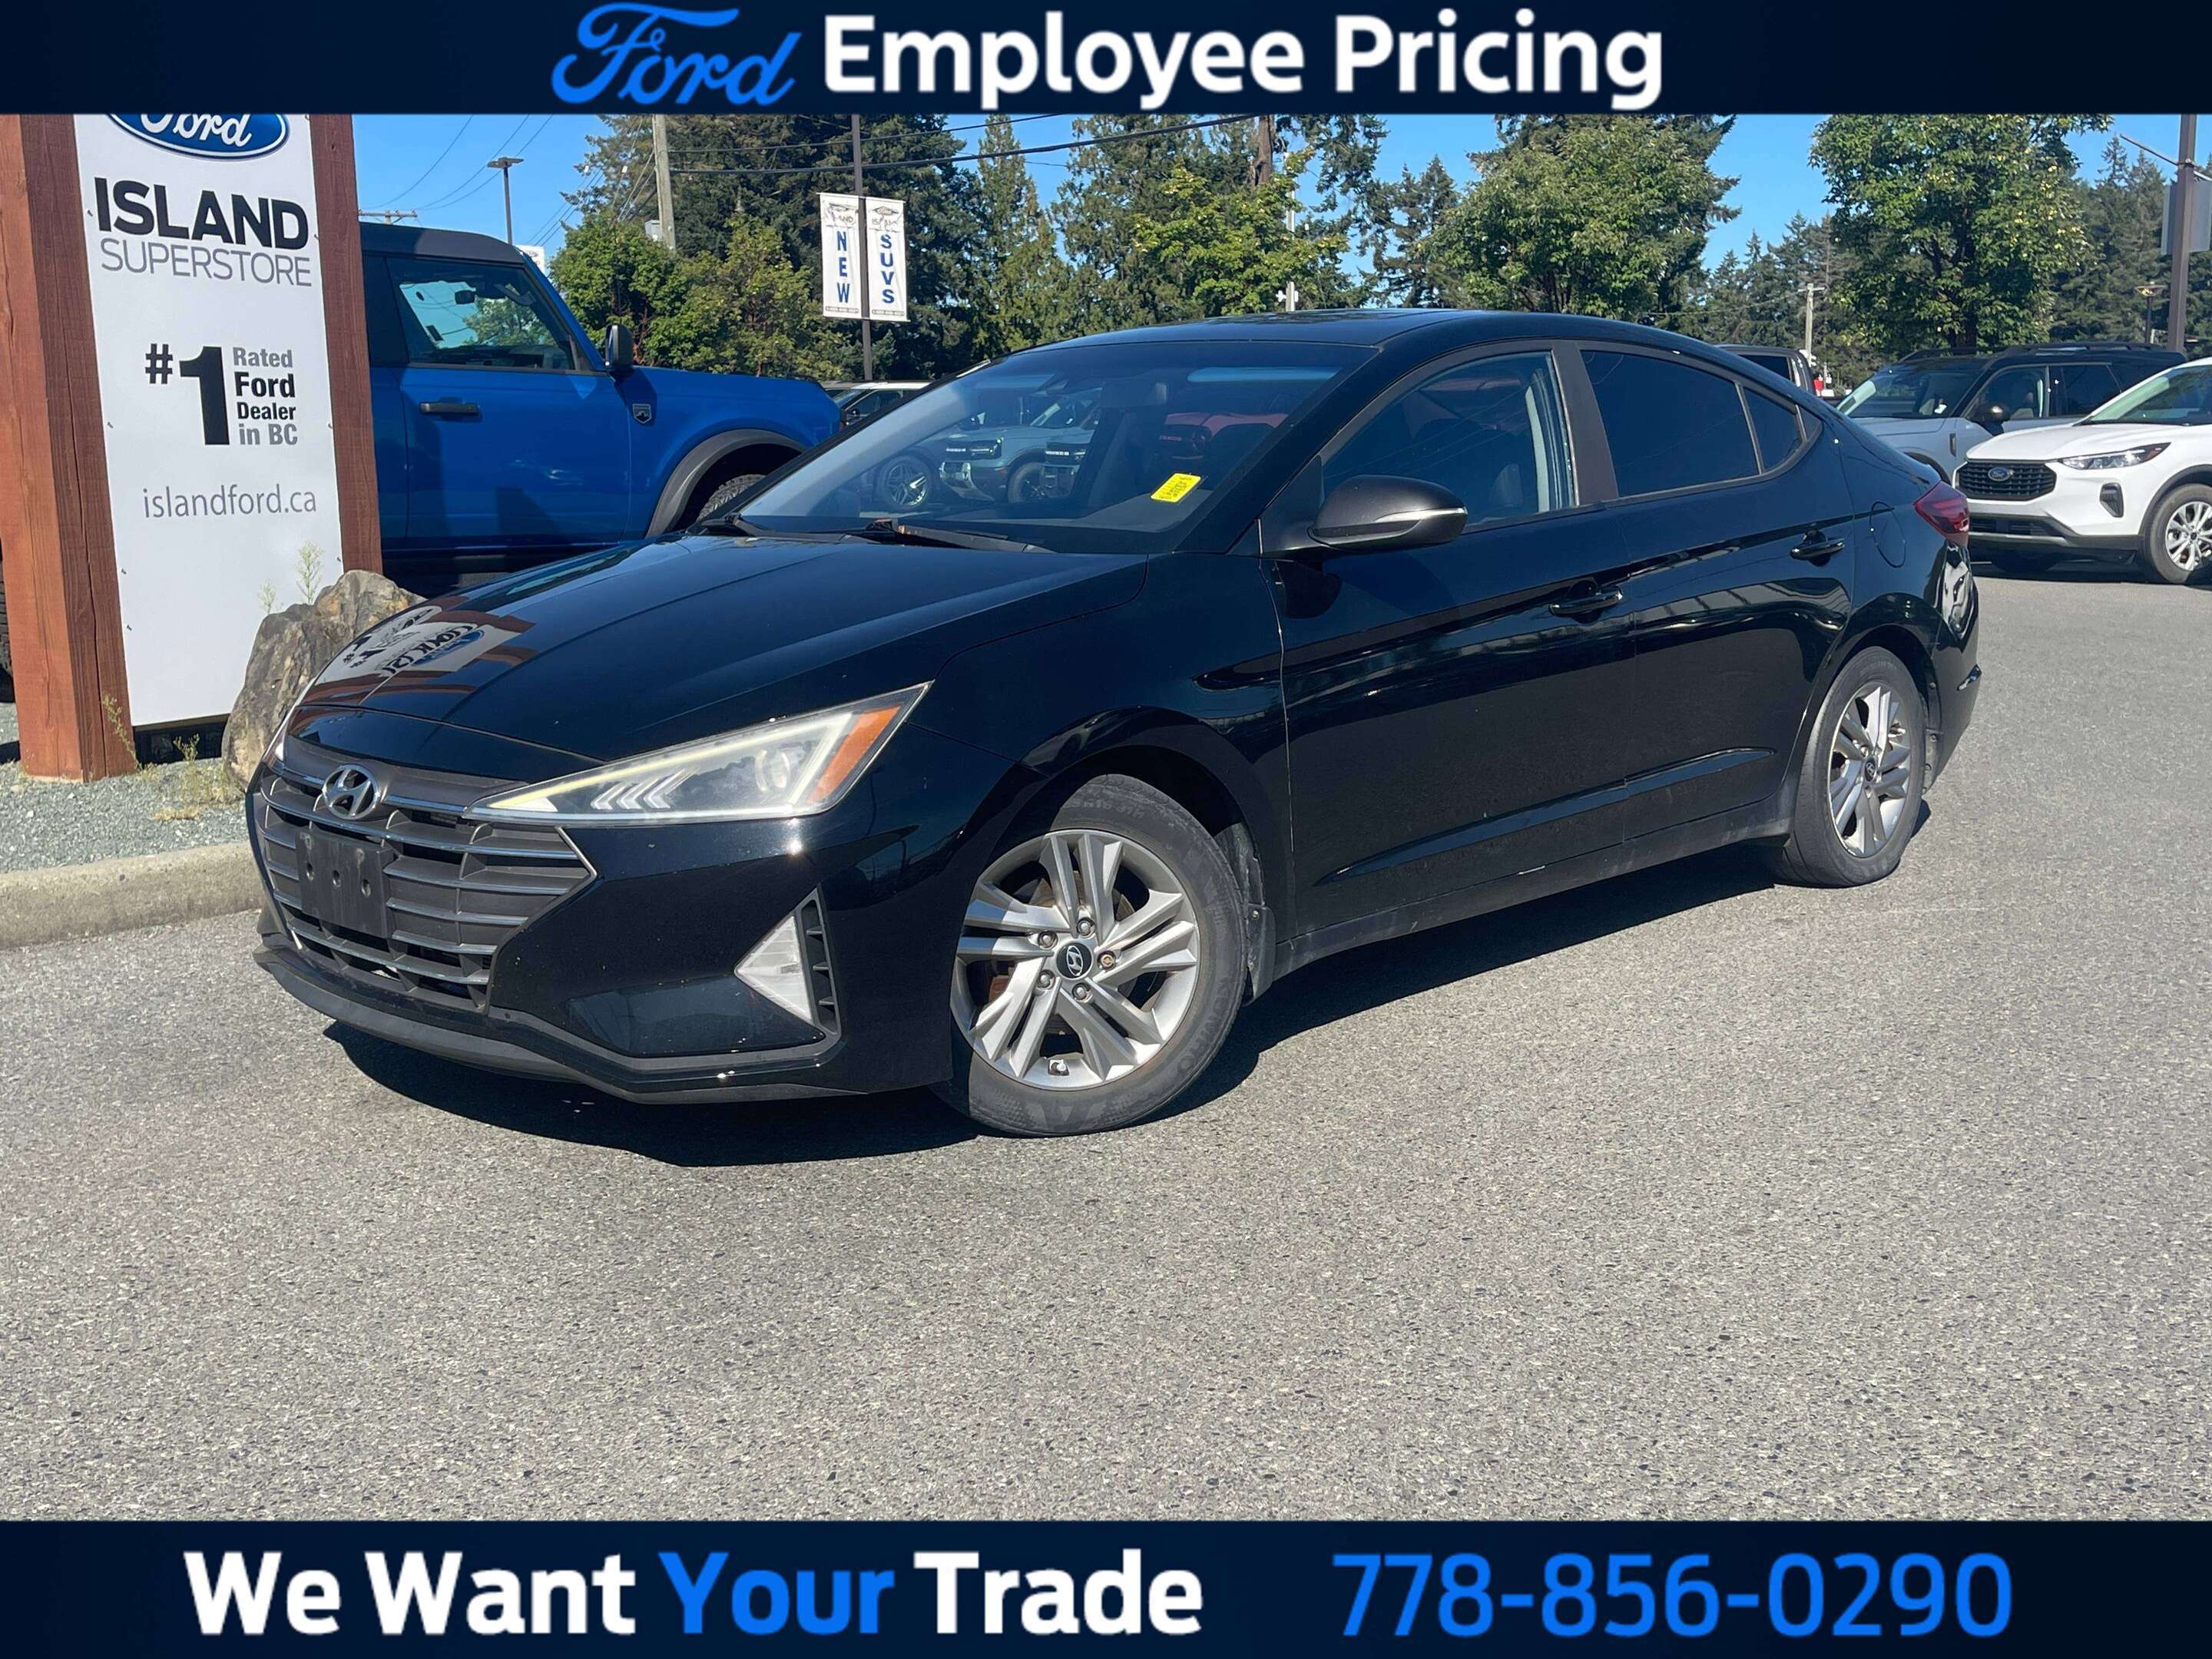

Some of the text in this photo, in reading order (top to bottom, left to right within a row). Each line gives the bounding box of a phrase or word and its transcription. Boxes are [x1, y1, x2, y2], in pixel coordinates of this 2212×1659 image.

[94, 177, 309, 250] ISLAND
[100, 237, 313, 287] SUPERSTORE
[836, 231, 850, 303] NEW
[880, 233, 895, 303] SUVS
[233, 346, 293, 368] Rated
[144, 343, 230, 446] #1
[233, 371, 296, 398] Ford
[237, 401, 296, 421] Dealer
[238, 422, 299, 446] in BC
[143, 483, 317, 518] islandford.ca
